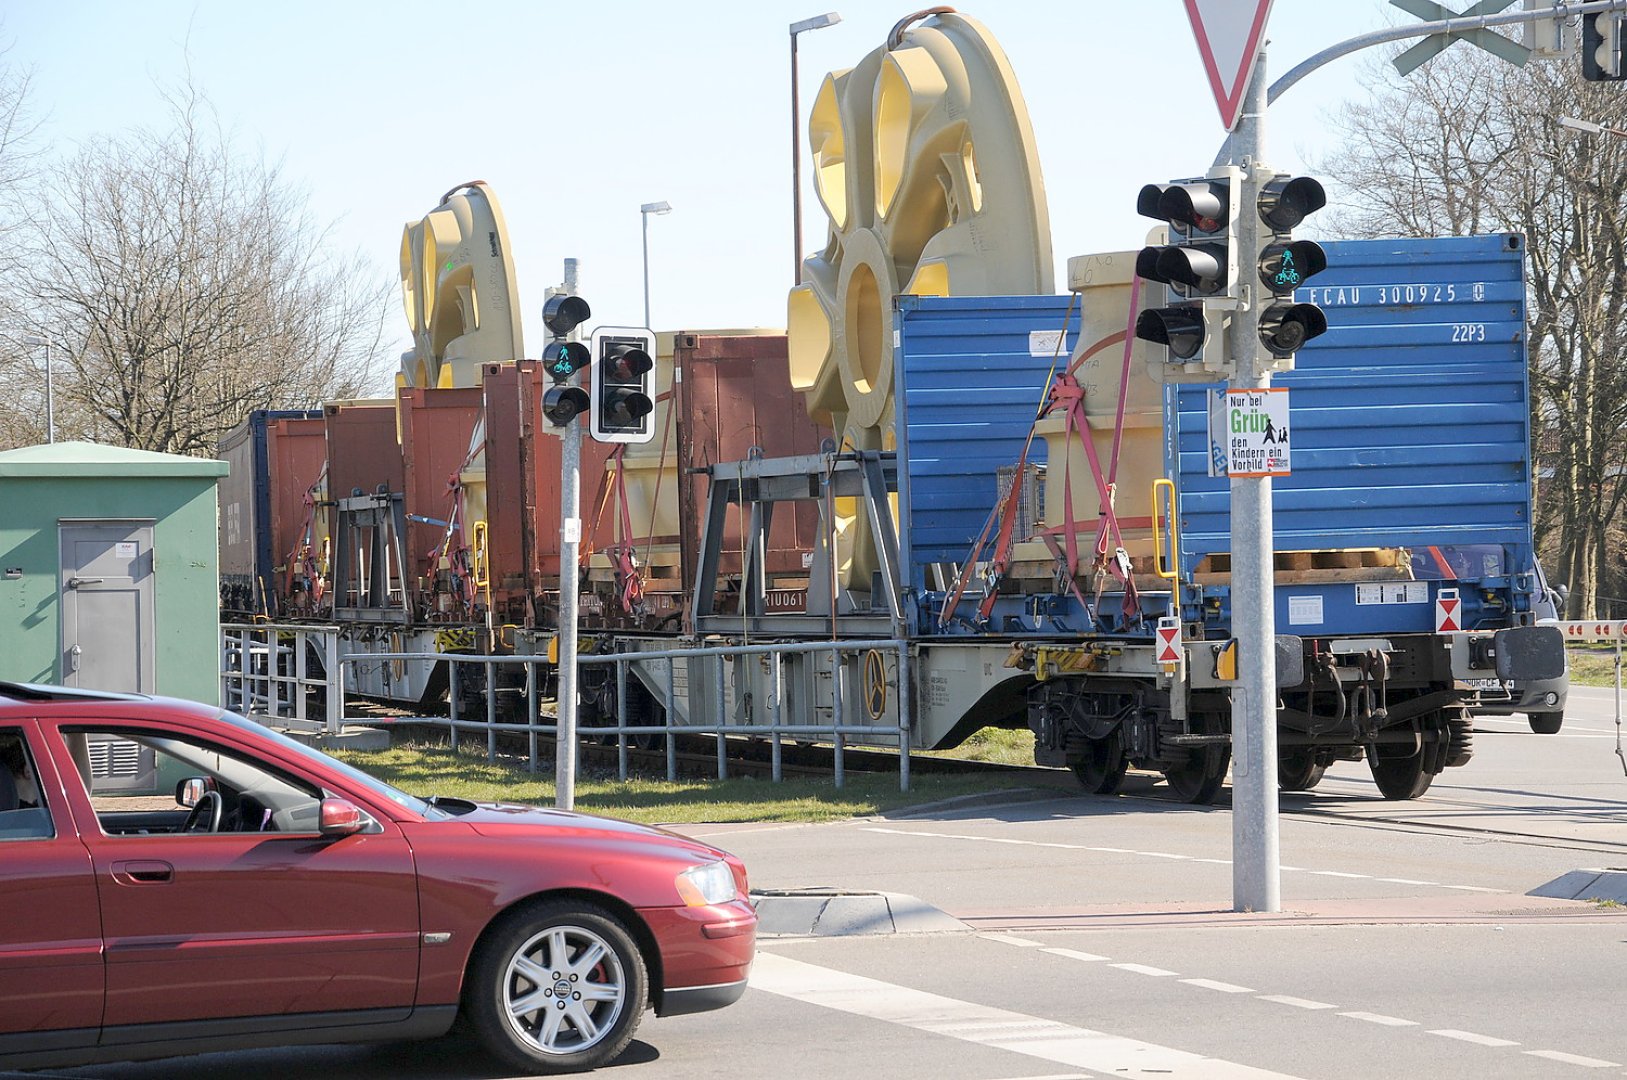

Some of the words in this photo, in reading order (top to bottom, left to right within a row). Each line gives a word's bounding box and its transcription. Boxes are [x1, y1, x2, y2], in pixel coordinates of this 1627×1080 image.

[1310, 288, 1359, 305] ECAU
[1378, 284, 1455, 304] 300925
[1474, 283, 1483, 301] 0
[1452, 325, 1485, 342] 22P3
[1230, 396, 1245, 407] Nur
[1249, 395, 1262, 406] bei
[1230, 408, 1269, 433] Grün
[1231, 437, 1247, 448] den
[1231, 448, 1265, 459] Kindern
[1269, 447, 1282, 457] ein
[1232, 459, 1263, 470] Vorbild
